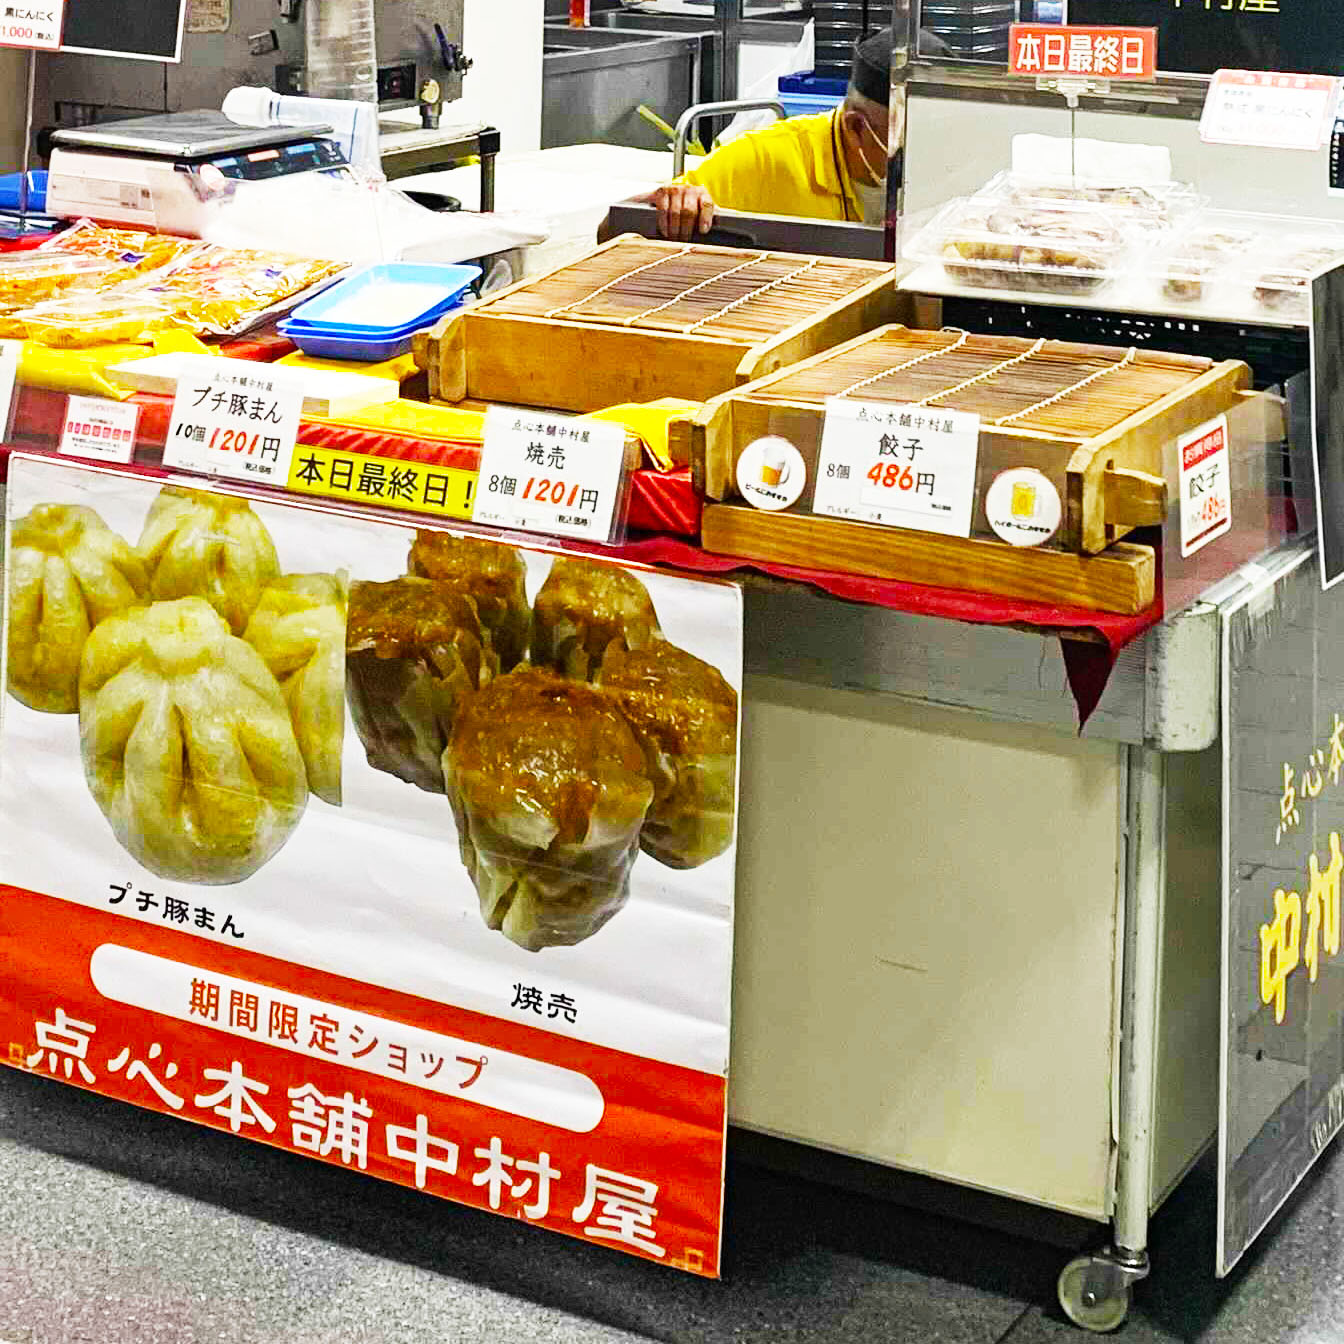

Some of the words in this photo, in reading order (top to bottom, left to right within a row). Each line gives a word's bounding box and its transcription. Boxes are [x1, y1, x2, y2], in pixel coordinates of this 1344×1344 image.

[1015, 33, 1145, 75] 本日最終日
[192, 386, 283, 424] プチ豚まん
[856, 407, 954, 433] 点心本舗中村屋
[175, 423, 206, 443] 10個
[208, 427, 281, 463] 1201円
[512, 419, 591, 444] 点心本舗中村屋
[878, 432, 924, 461] 餃子
[524, 441, 566, 470] 焼売
[488, 474, 517, 496] 8個
[522, 477, 599, 513] 1201円
[827, 463, 851, 479] 8個
[867, 462, 935, 496] 486円
[108, 881, 246, 939] プチ豚まん
[509, 981, 578, 1024] 焼売
[188, 978, 489, 1090] 期間限定ショップ
[26, 1008, 668, 1259] 点心本舗中村屋
